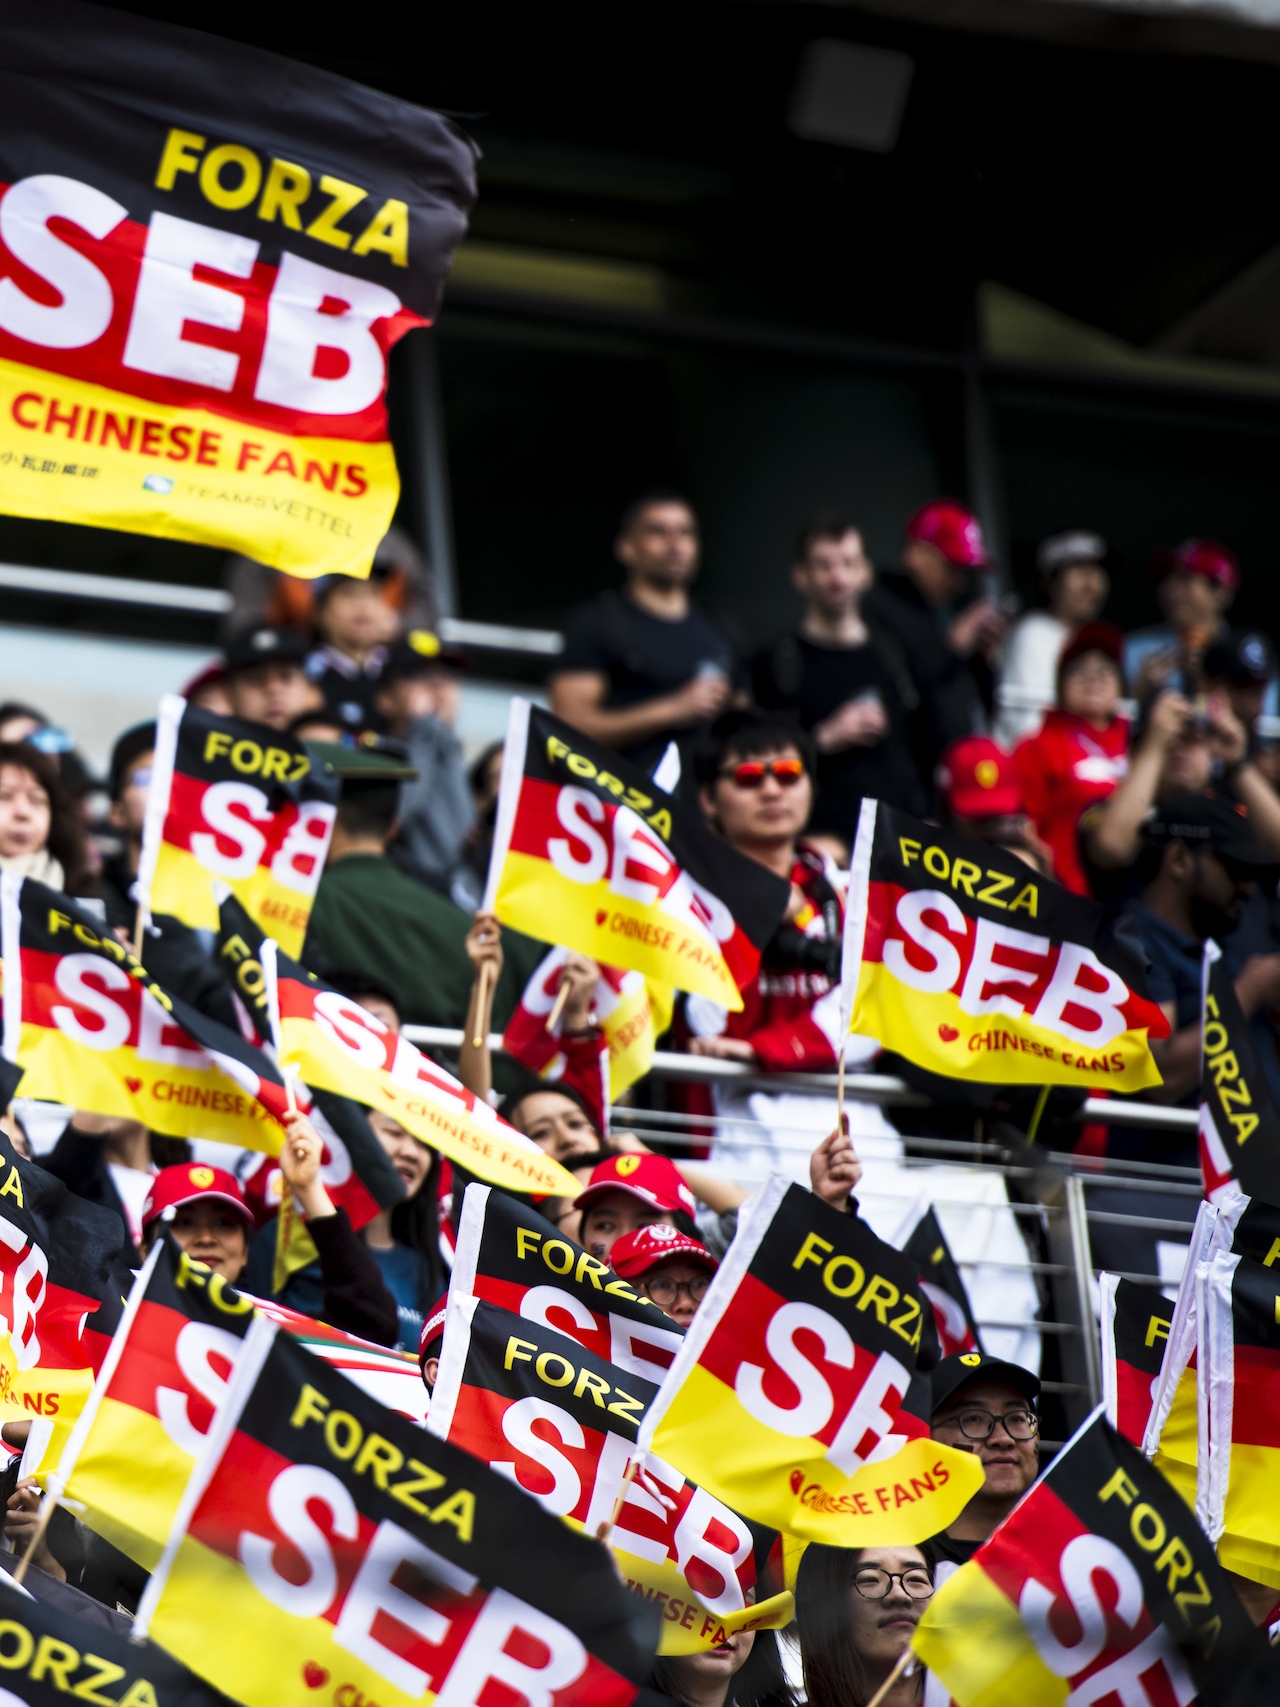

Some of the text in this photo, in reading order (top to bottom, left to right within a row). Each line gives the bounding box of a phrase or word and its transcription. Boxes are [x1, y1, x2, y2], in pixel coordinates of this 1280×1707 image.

[154, 128, 410, 268] FORZA
[11, 391, 370, 498] CHINESE FANS
[204, 731, 311, 783] FORZ
[546, 735, 673, 843] FORZA
[899, 836, 1039, 920] FORZA
[610, 911, 728, 982] CHINESE FANS
[882, 888, 1131, 1049] SEB
[151, 1079, 244, 1115] CHINESE
[967, 1029, 1126, 1076] CHINESE FANS
[1204, 993, 1261, 1147] FORZA
[405, 1100, 558, 1189] CHINESE FANS
[516, 1226, 671, 1319] FORZ
[504, 1336, 646, 1426] FORZ
[289, 1383, 477, 1543] FORZA
[489, 1396, 755, 1618] SEB
[874, 1460, 951, 1512] FANS
[238, 1463, 589, 1707] SEB
[1097, 1466, 1222, 1660] FORZA
[1019, 1532, 1200, 1707] SE
